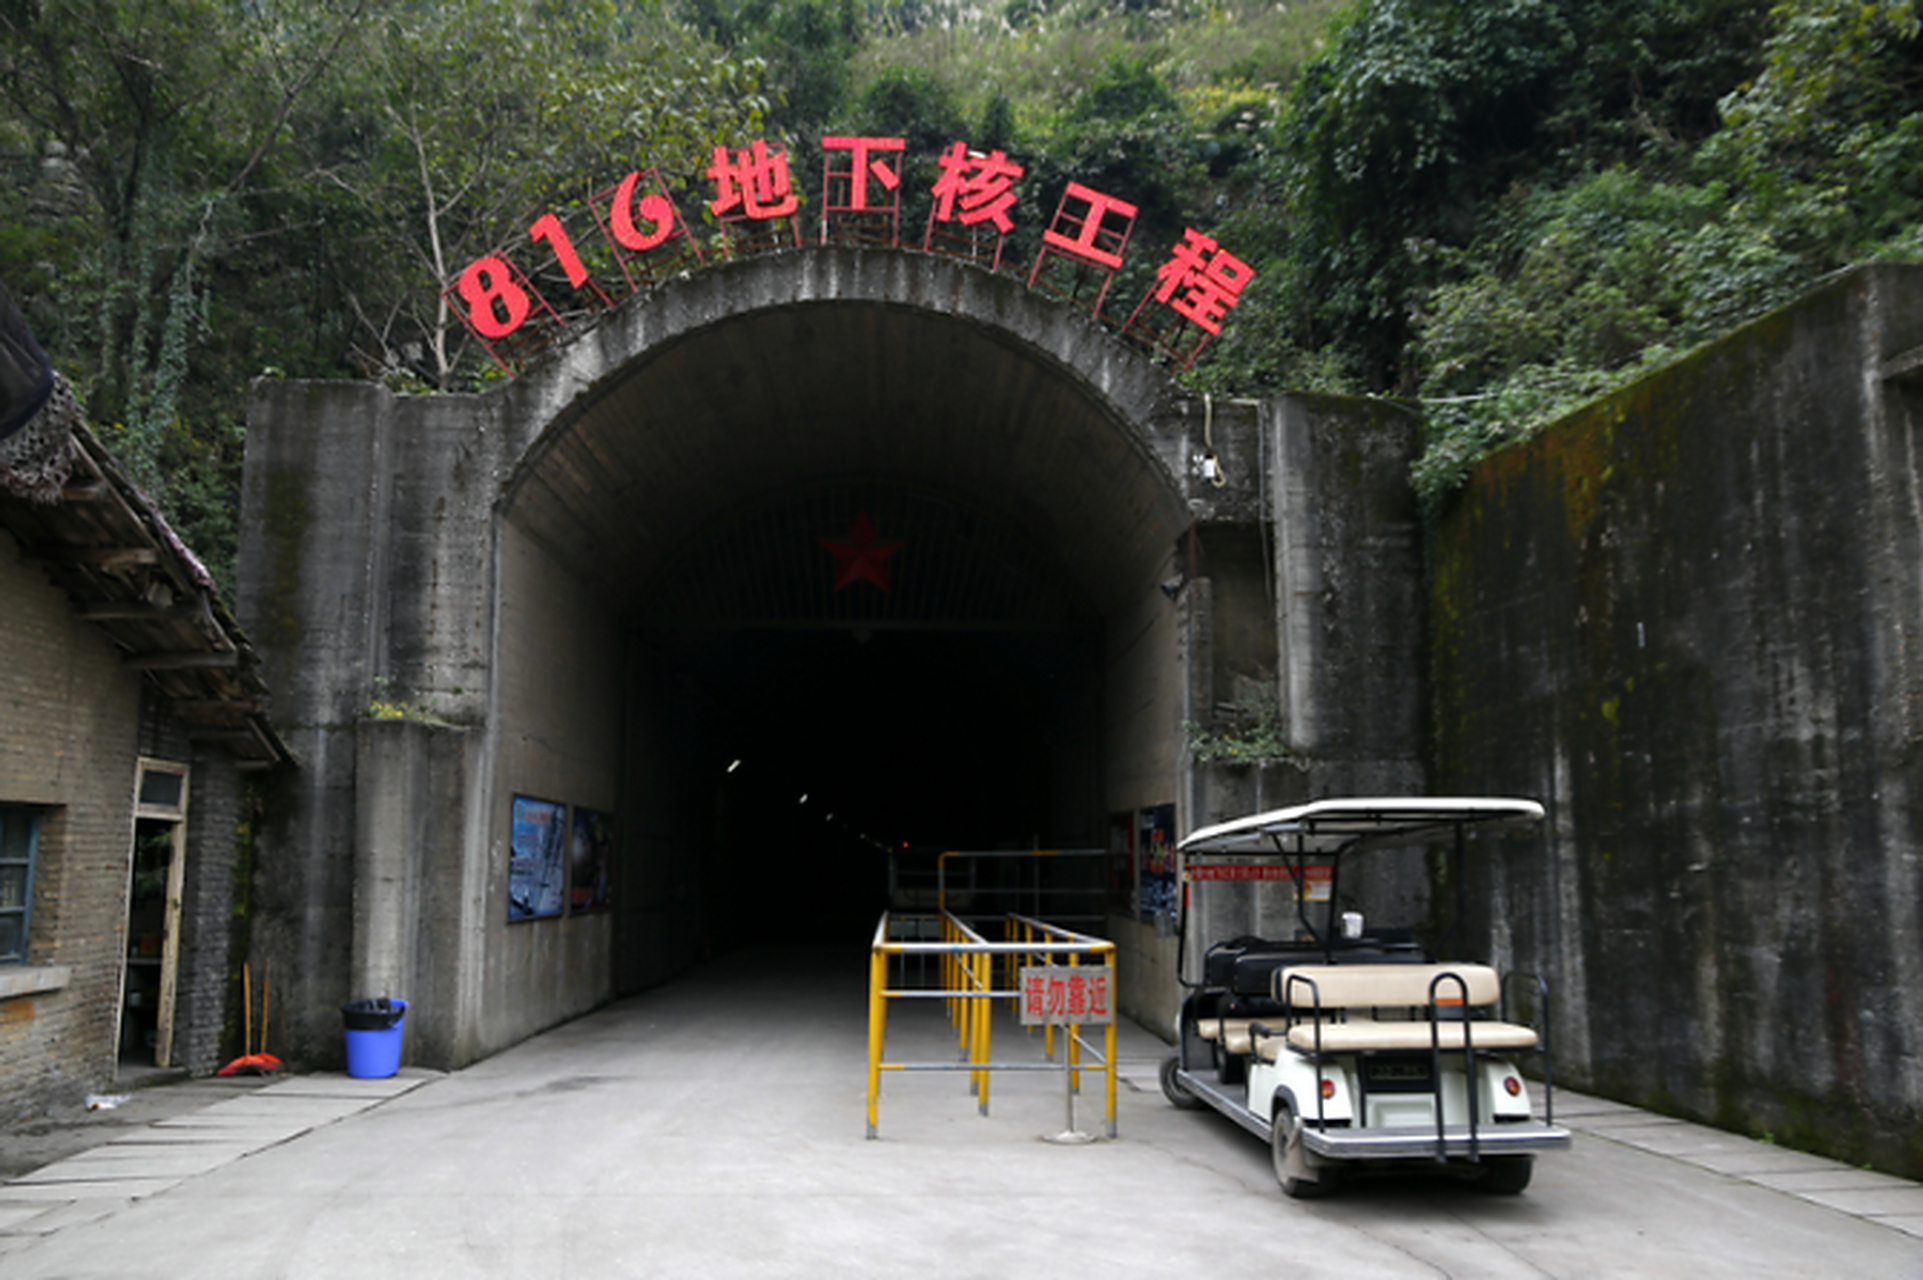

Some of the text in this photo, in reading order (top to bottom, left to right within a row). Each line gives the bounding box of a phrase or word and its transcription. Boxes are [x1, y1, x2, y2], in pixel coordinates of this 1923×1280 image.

[456, 136, 1255, 338] 816地下核工程
[1024, 975, 1108, 1018] 请勿靠近
